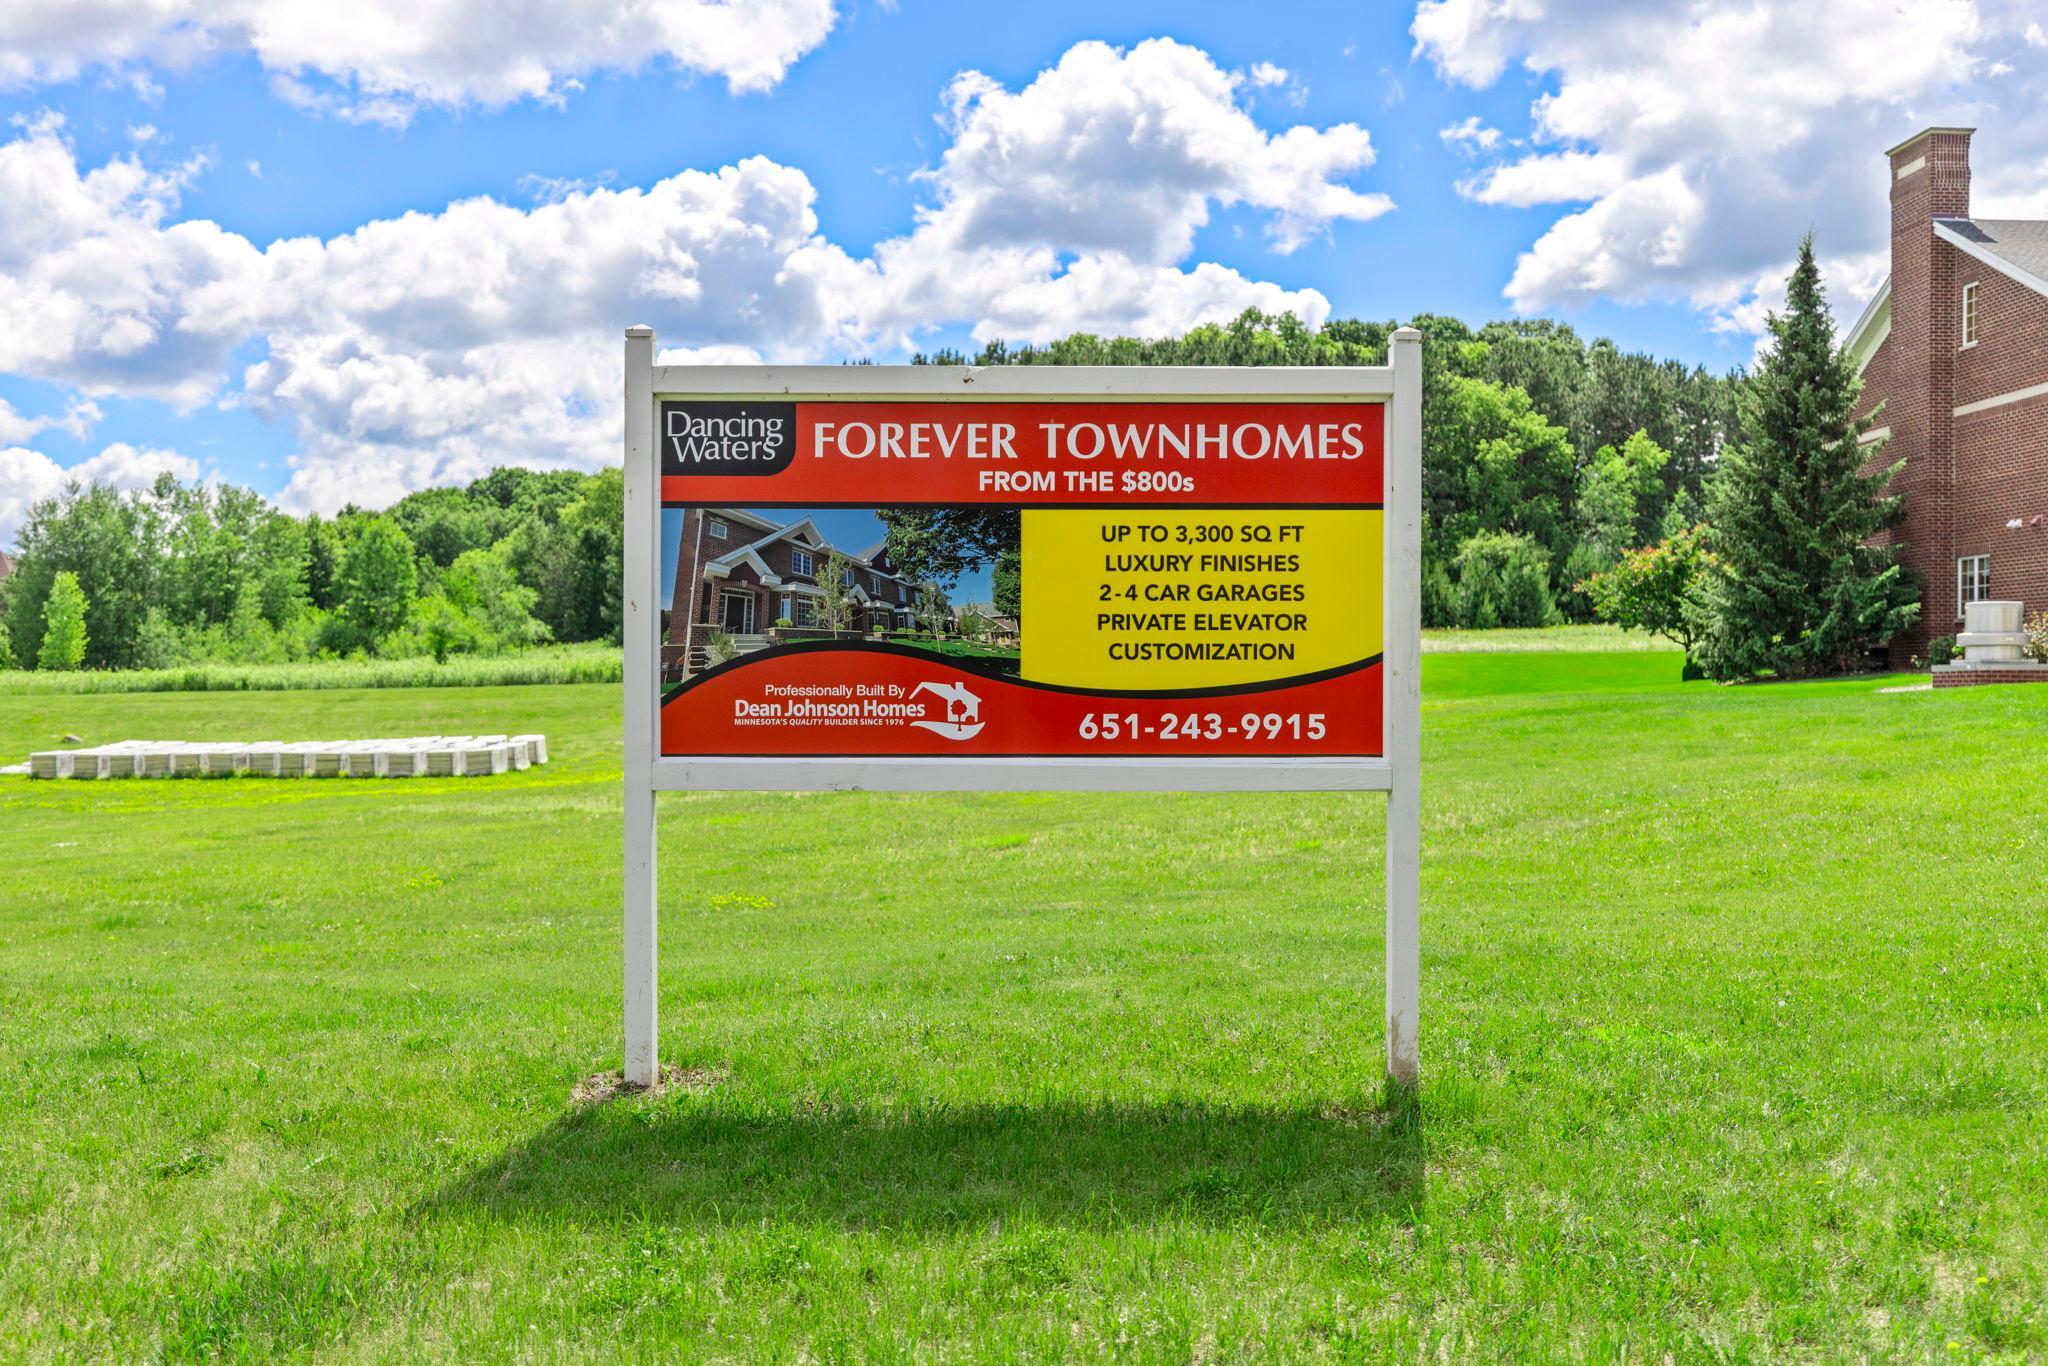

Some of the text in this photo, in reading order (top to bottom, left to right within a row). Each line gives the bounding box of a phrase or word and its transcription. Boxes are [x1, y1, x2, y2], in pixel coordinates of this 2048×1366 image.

[666, 411, 784, 447] Dancing
[672, 436, 776, 463] Waters
[813, 422, 1365, 460] FOREVER TOWNHOMES
[979, 469, 1195, 494] FROM THE $800s
[1101, 525, 1305, 545] UP TO 3,300 SQ FT
[1105, 554, 1300, 572] LUXURY FINISHES
[1144, 584, 1191, 602] CAR
[1196, 584, 1305, 602] GARAGES
[1097, 613, 1308, 631] PRIVATE ELEVATOR
[1108, 643, 1295, 661] CUSTOMIZATION
[765, 684, 906, 699] Professionally Built By
[735, 699, 926, 717] Dean Johnson Homes
[734, 718, 905, 726] MINNESOTA'S QUALITY BUILDER SINCE 1976
[1078, 713, 1327, 740] 651-243-9915
